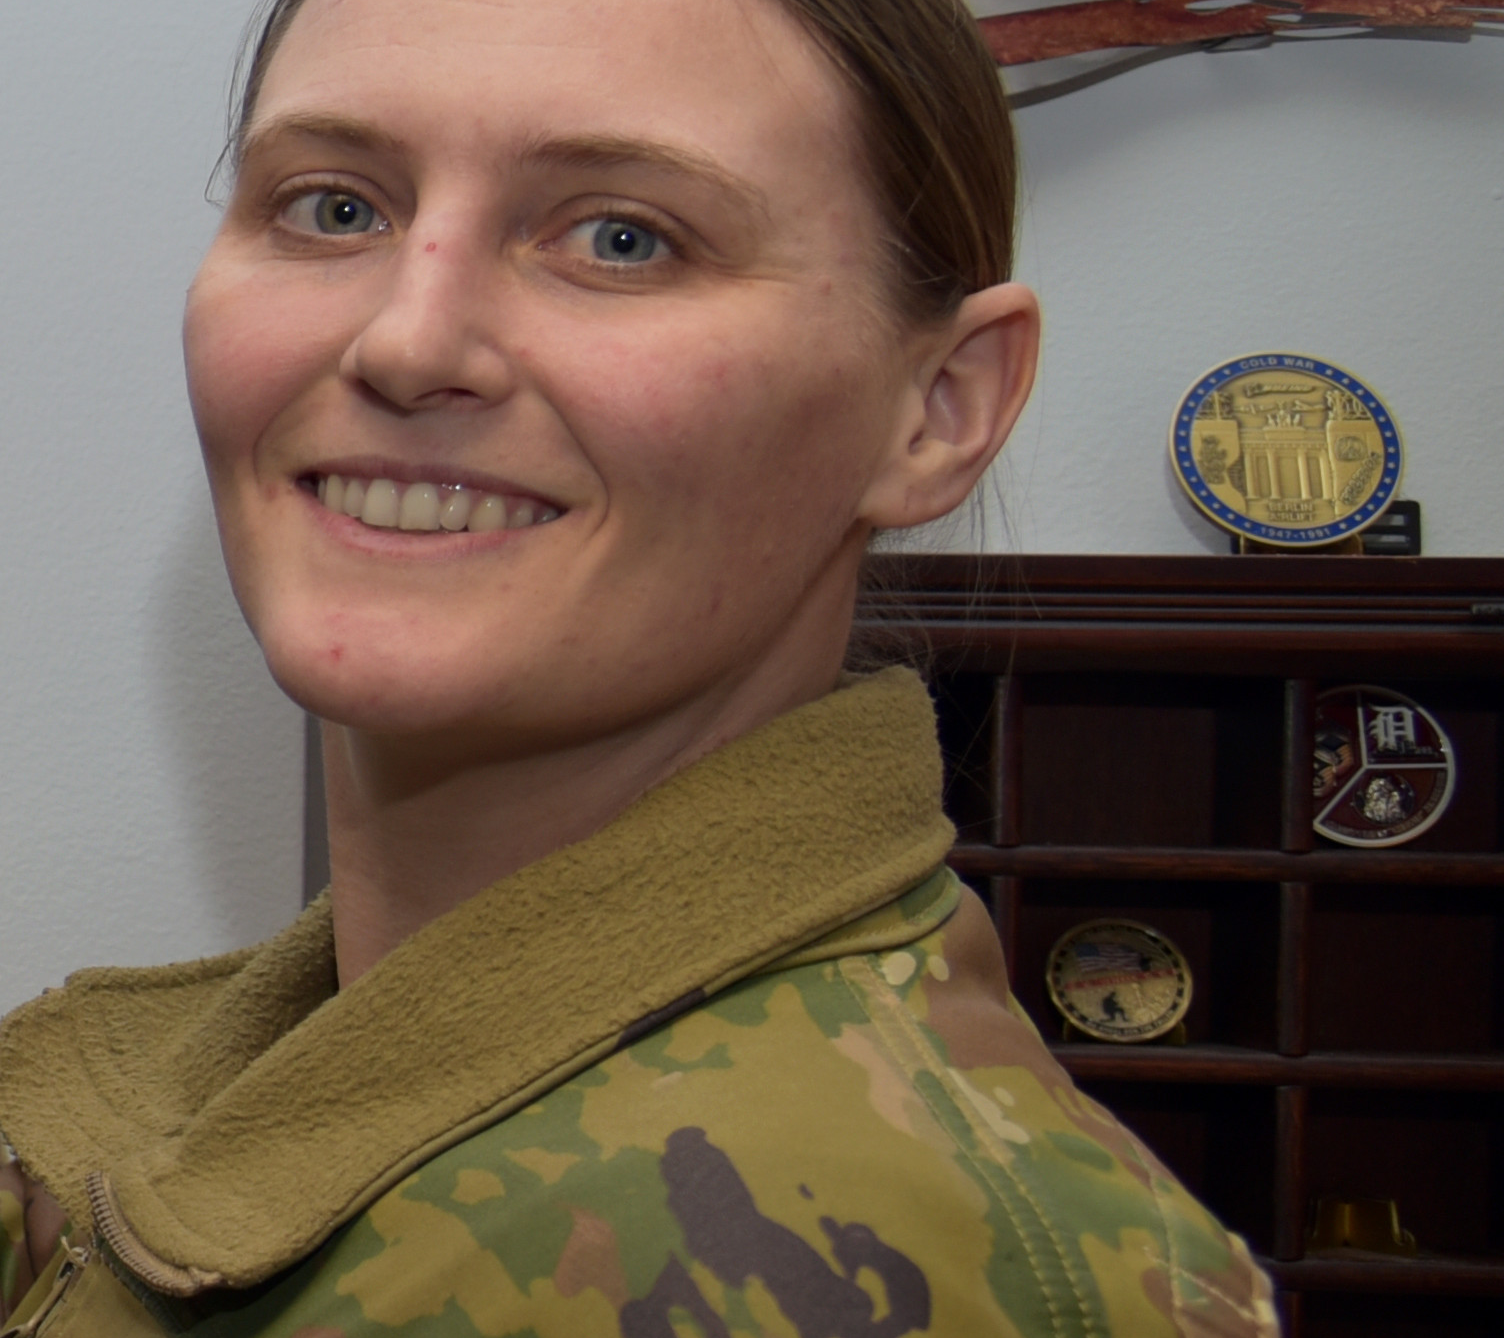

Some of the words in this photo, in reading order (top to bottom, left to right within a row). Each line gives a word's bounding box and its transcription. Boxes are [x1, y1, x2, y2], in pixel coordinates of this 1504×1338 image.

[1240, 356, 1278, 370] COLD
[1282, 357, 1315, 371] WAR
[1260, 526, 1331, 541] 1947-1991
